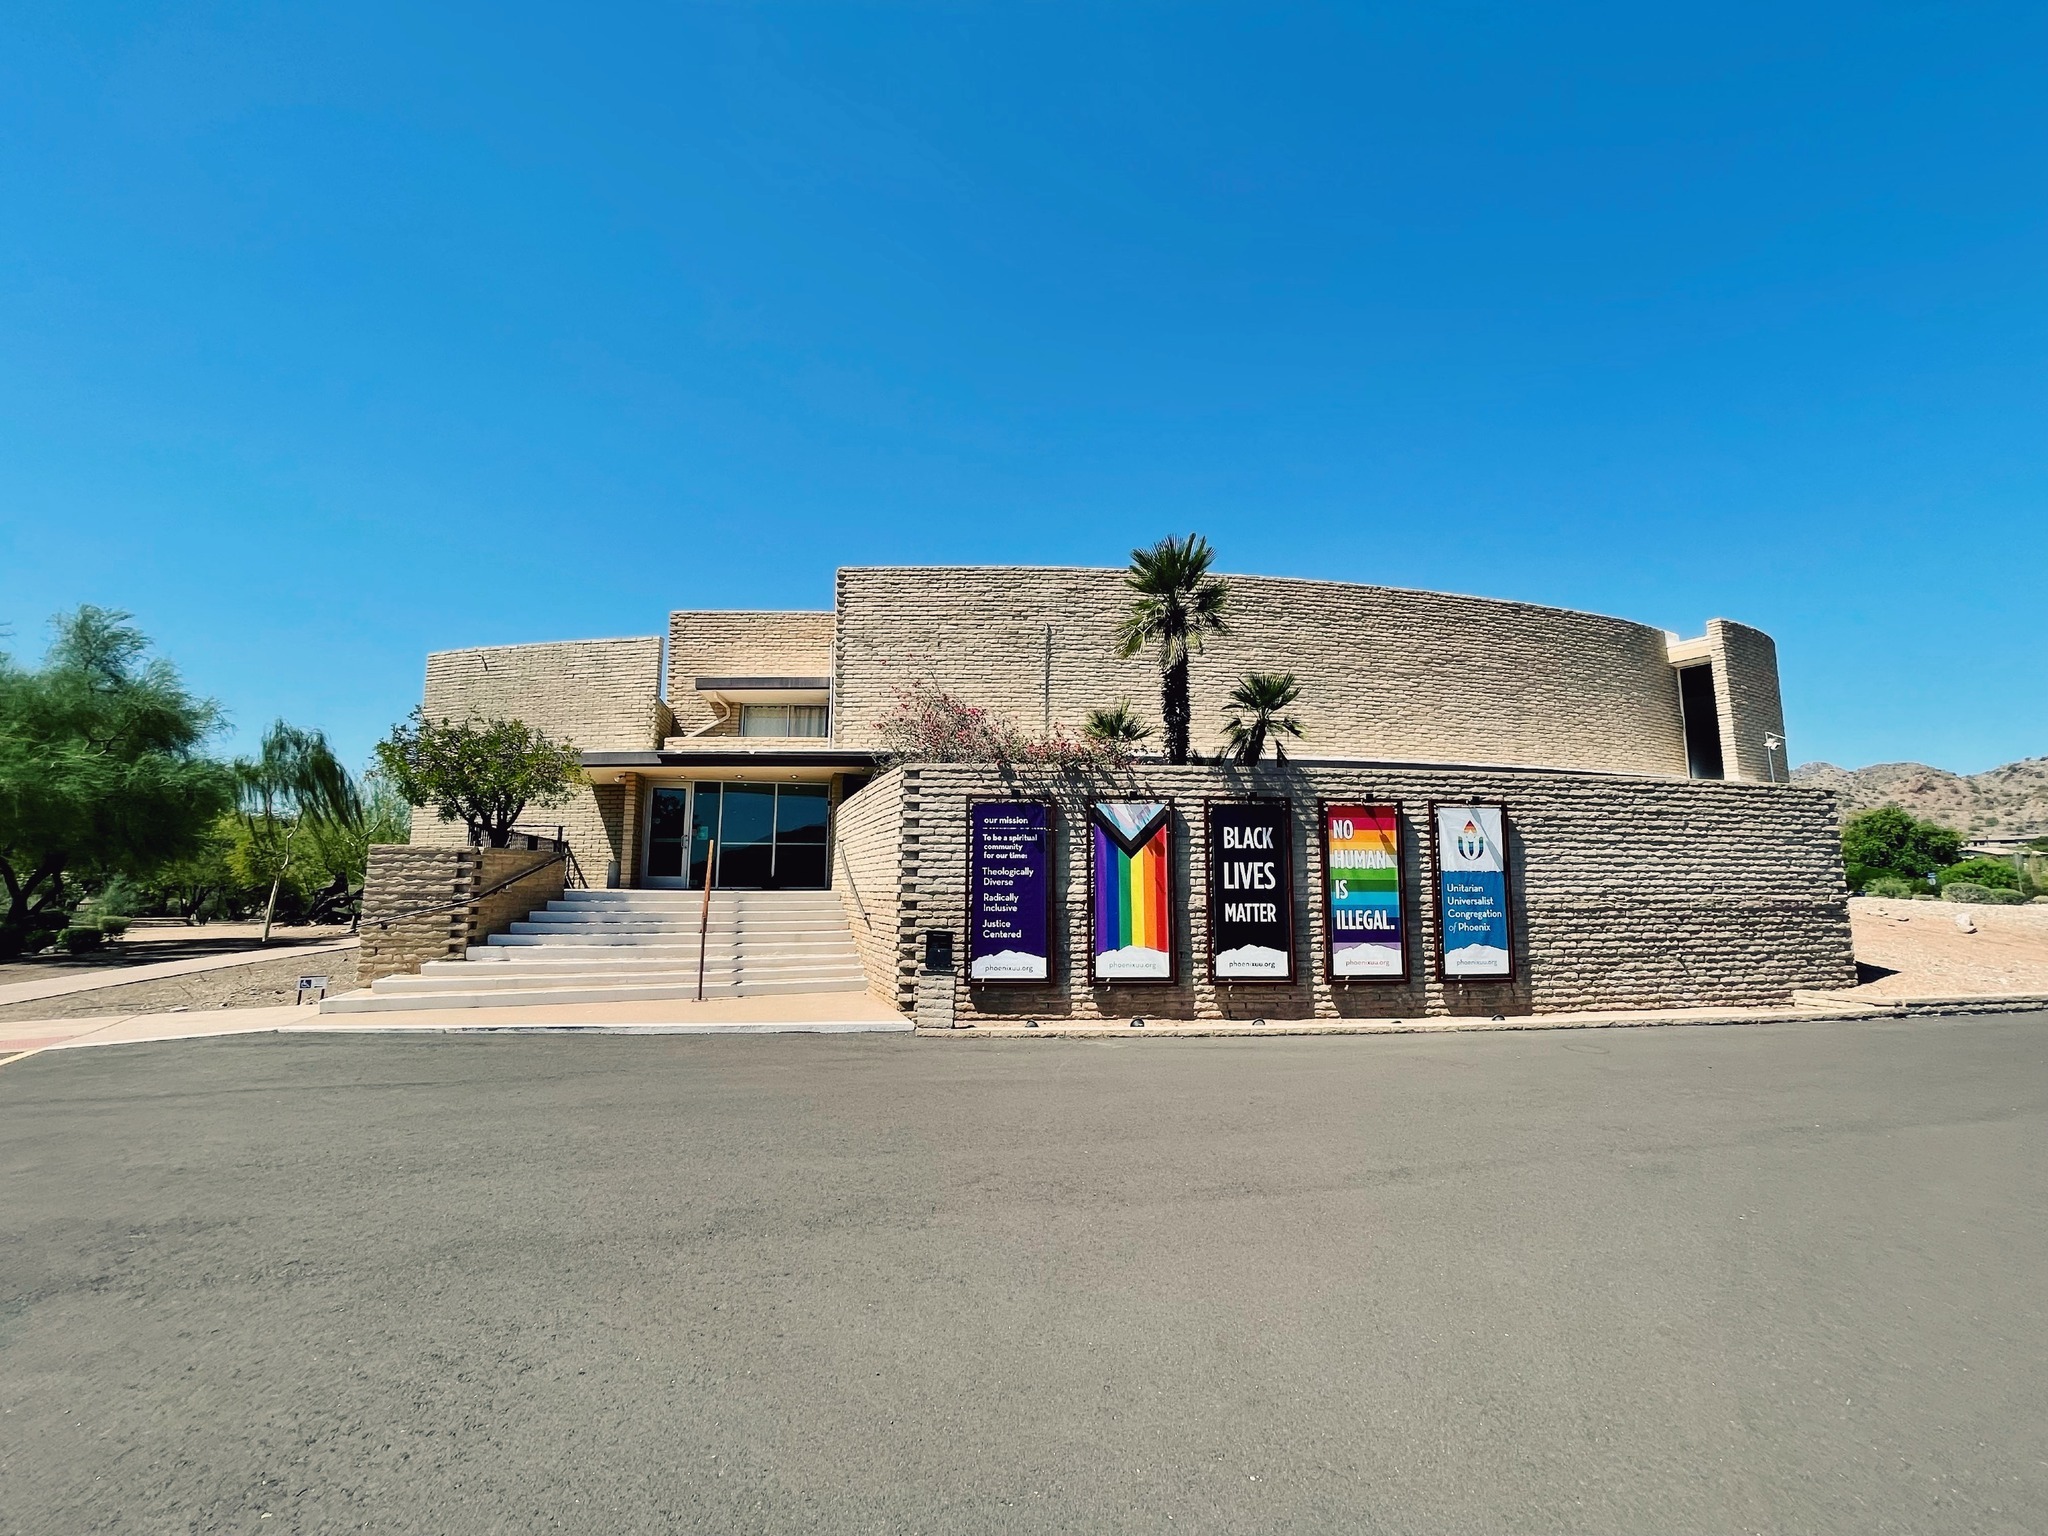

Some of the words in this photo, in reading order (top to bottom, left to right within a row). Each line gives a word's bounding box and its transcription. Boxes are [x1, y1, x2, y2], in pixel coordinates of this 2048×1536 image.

[999, 816, 1028, 824] mission
[1332, 820, 1354, 840] NO
[1009, 834, 1037, 843] spiritual
[1223, 827, 1274, 849] BLACK
[984, 844, 1023, 852] community
[1334, 850, 1387, 869] HUMAN
[982, 867, 1034, 877] Theologically
[1223, 862, 1276, 890] LIVES
[983, 878, 1013, 886] Diverse
[1335, 880, 1348, 899] IS
[1447, 884, 1483, 893] Unitarian
[983, 893, 1019, 903] Radically
[1448, 897, 1494, 905] Universalist
[983, 904, 1017, 912] Inclusive
[1224, 903, 1277, 922] MATTER
[1448, 910, 1502, 919] Congregation
[982, 920, 1011, 928] Justice
[1336, 910, 1395, 930] ILLEGAL.
[1449, 923, 1457, 933] of
[983, 930, 1021, 938] Centered
[1109, 961, 1157, 969] phoenixuu.org
[1346, 959, 1390, 967] phoenixuu.org
[985, 964, 1033, 973] phoenixuu.org
